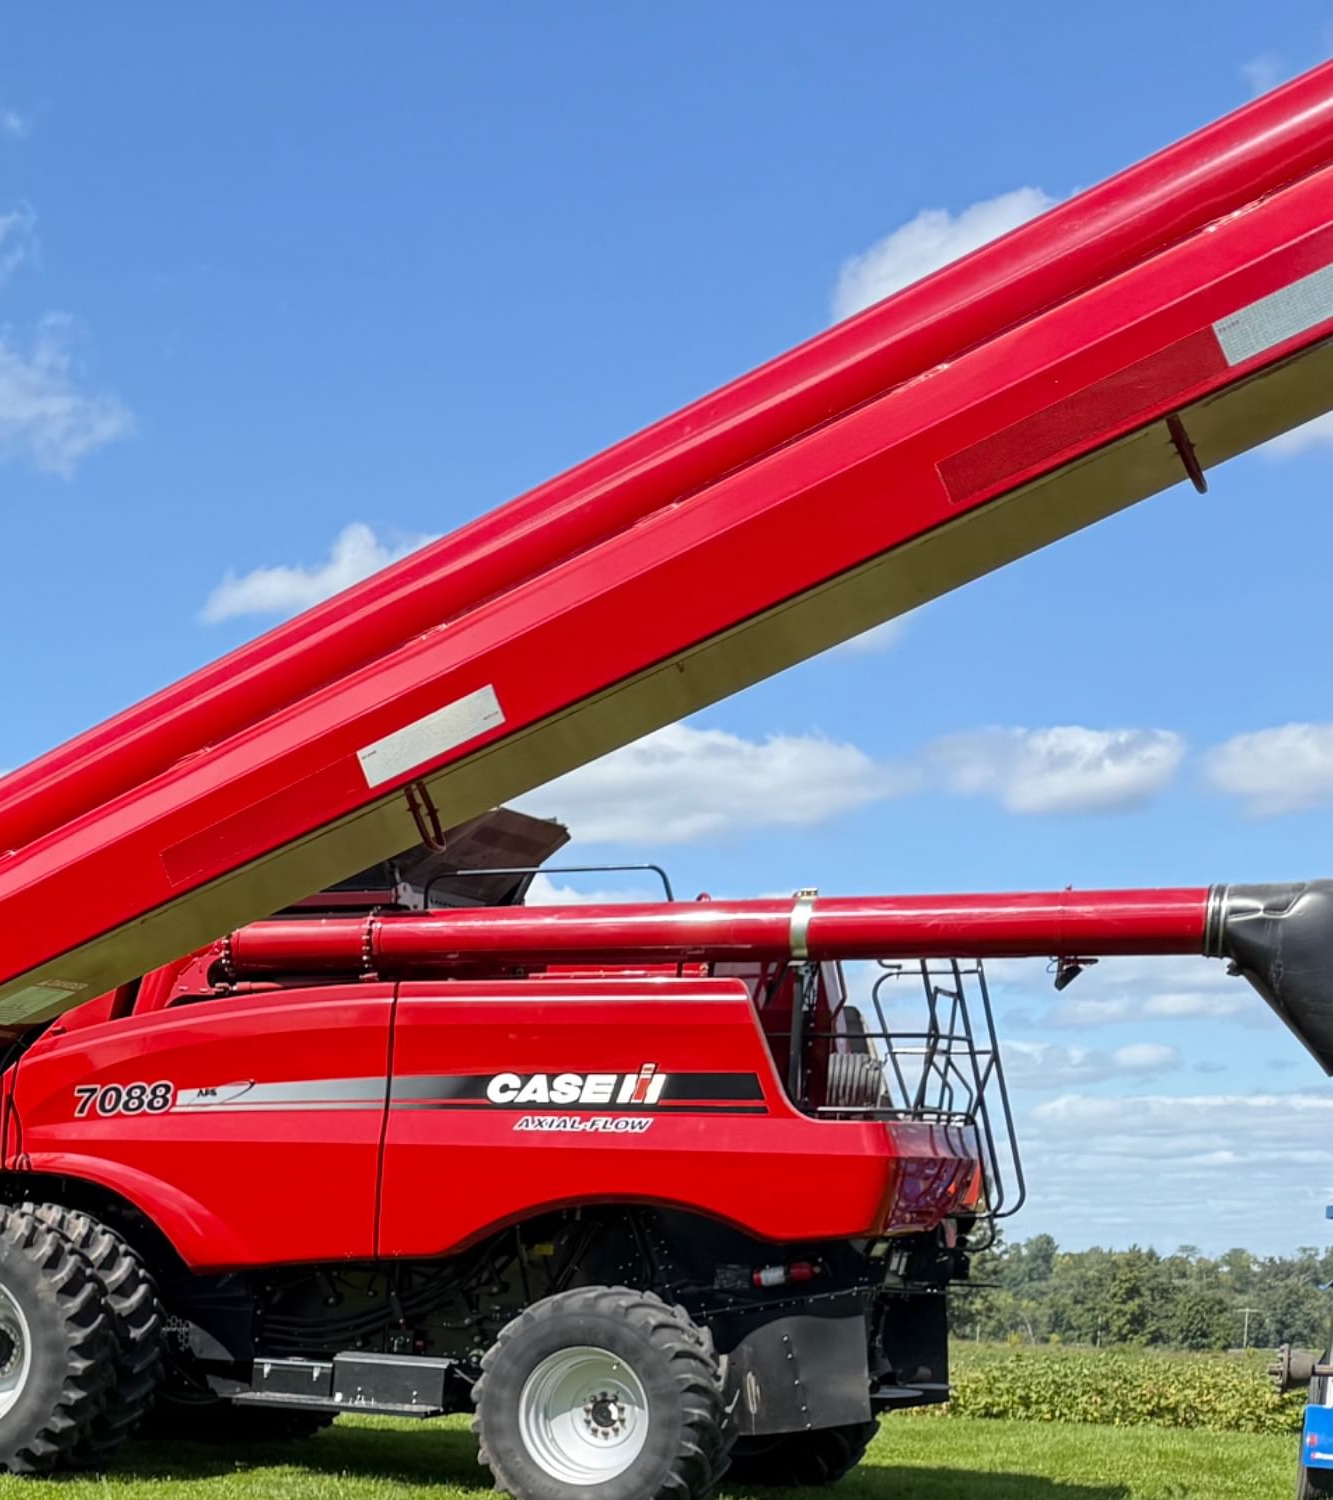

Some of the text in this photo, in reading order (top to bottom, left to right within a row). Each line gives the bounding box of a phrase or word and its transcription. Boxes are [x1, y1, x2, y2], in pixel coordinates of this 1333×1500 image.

[74, 1082, 173, 1117] 7088
[486, 1073, 618, 1104] CASE
[514, 1116, 653, 1132] AXIAL-FLOW
